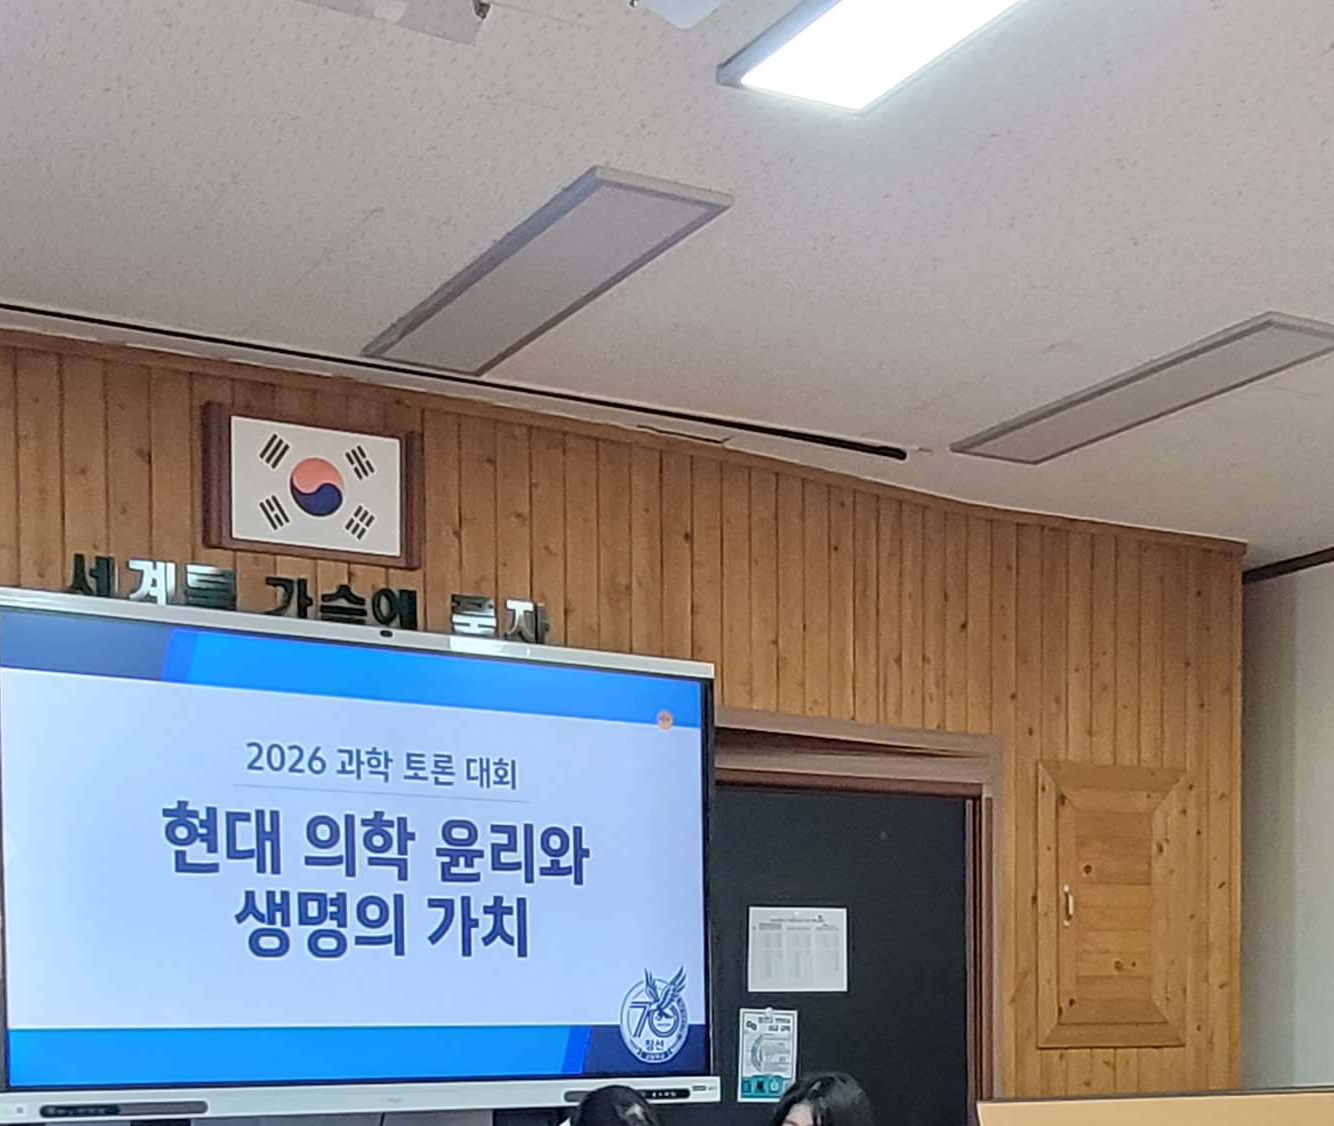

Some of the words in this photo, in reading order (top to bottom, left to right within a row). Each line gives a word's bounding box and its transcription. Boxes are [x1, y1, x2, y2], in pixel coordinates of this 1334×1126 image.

[246, 741, 327, 775] 2026
[336, 747, 393, 783] 과학
[403, 751, 456, 787] 토론
[465, 756, 517, 790] 대회
[162, 800, 282, 875] 현대
[303, 810, 416, 881] 의학
[435, 818, 590, 886] 윤리와
[234, 889, 405, 959] 생명의
[427, 895, 528, 958] 가치
